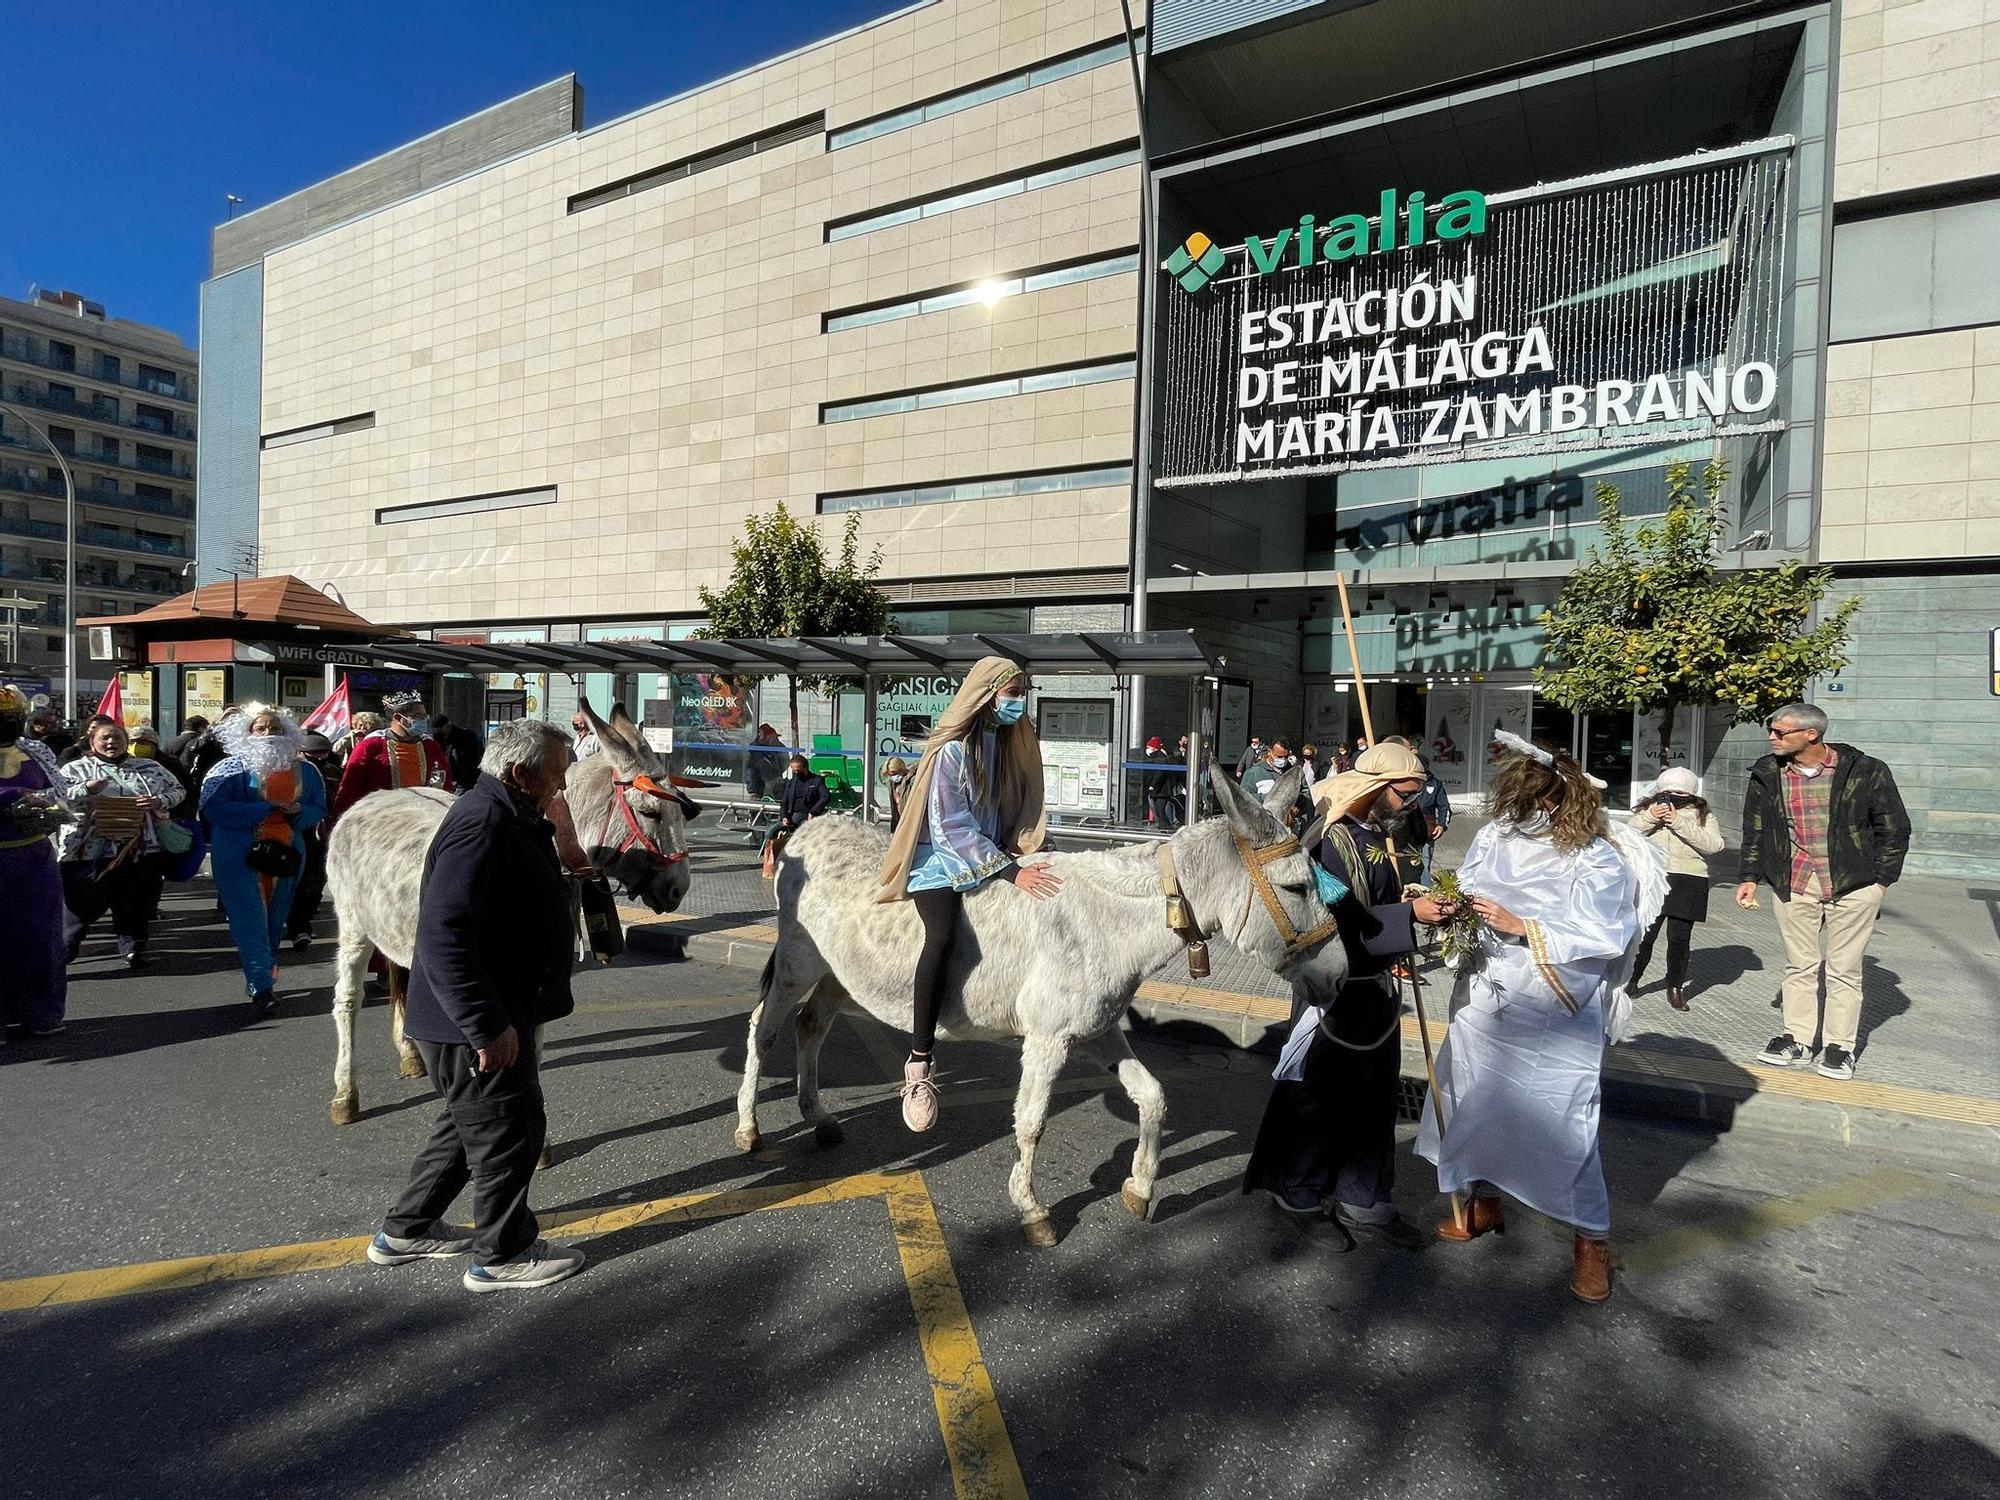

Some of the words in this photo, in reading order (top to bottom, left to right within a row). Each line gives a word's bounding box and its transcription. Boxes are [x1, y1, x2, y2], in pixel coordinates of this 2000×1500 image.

[1244, 188, 1486, 274] vialia
[1240, 271, 1475, 354] ESTACIÓN
[1238, 360, 1299, 409] DE
[1320, 326, 1555, 399] MÁLAGA
[1237, 399, 1401, 463] MARÍA
[1420, 361, 1777, 443] ZAMBRANO
[315, 649, 368, 664] GRATIS
[188, 699, 201, 707] TRES
[681, 695, 700, 707] Neo
[701, 696, 725, 707] QLED
[726, 696, 737, 707] 8K
